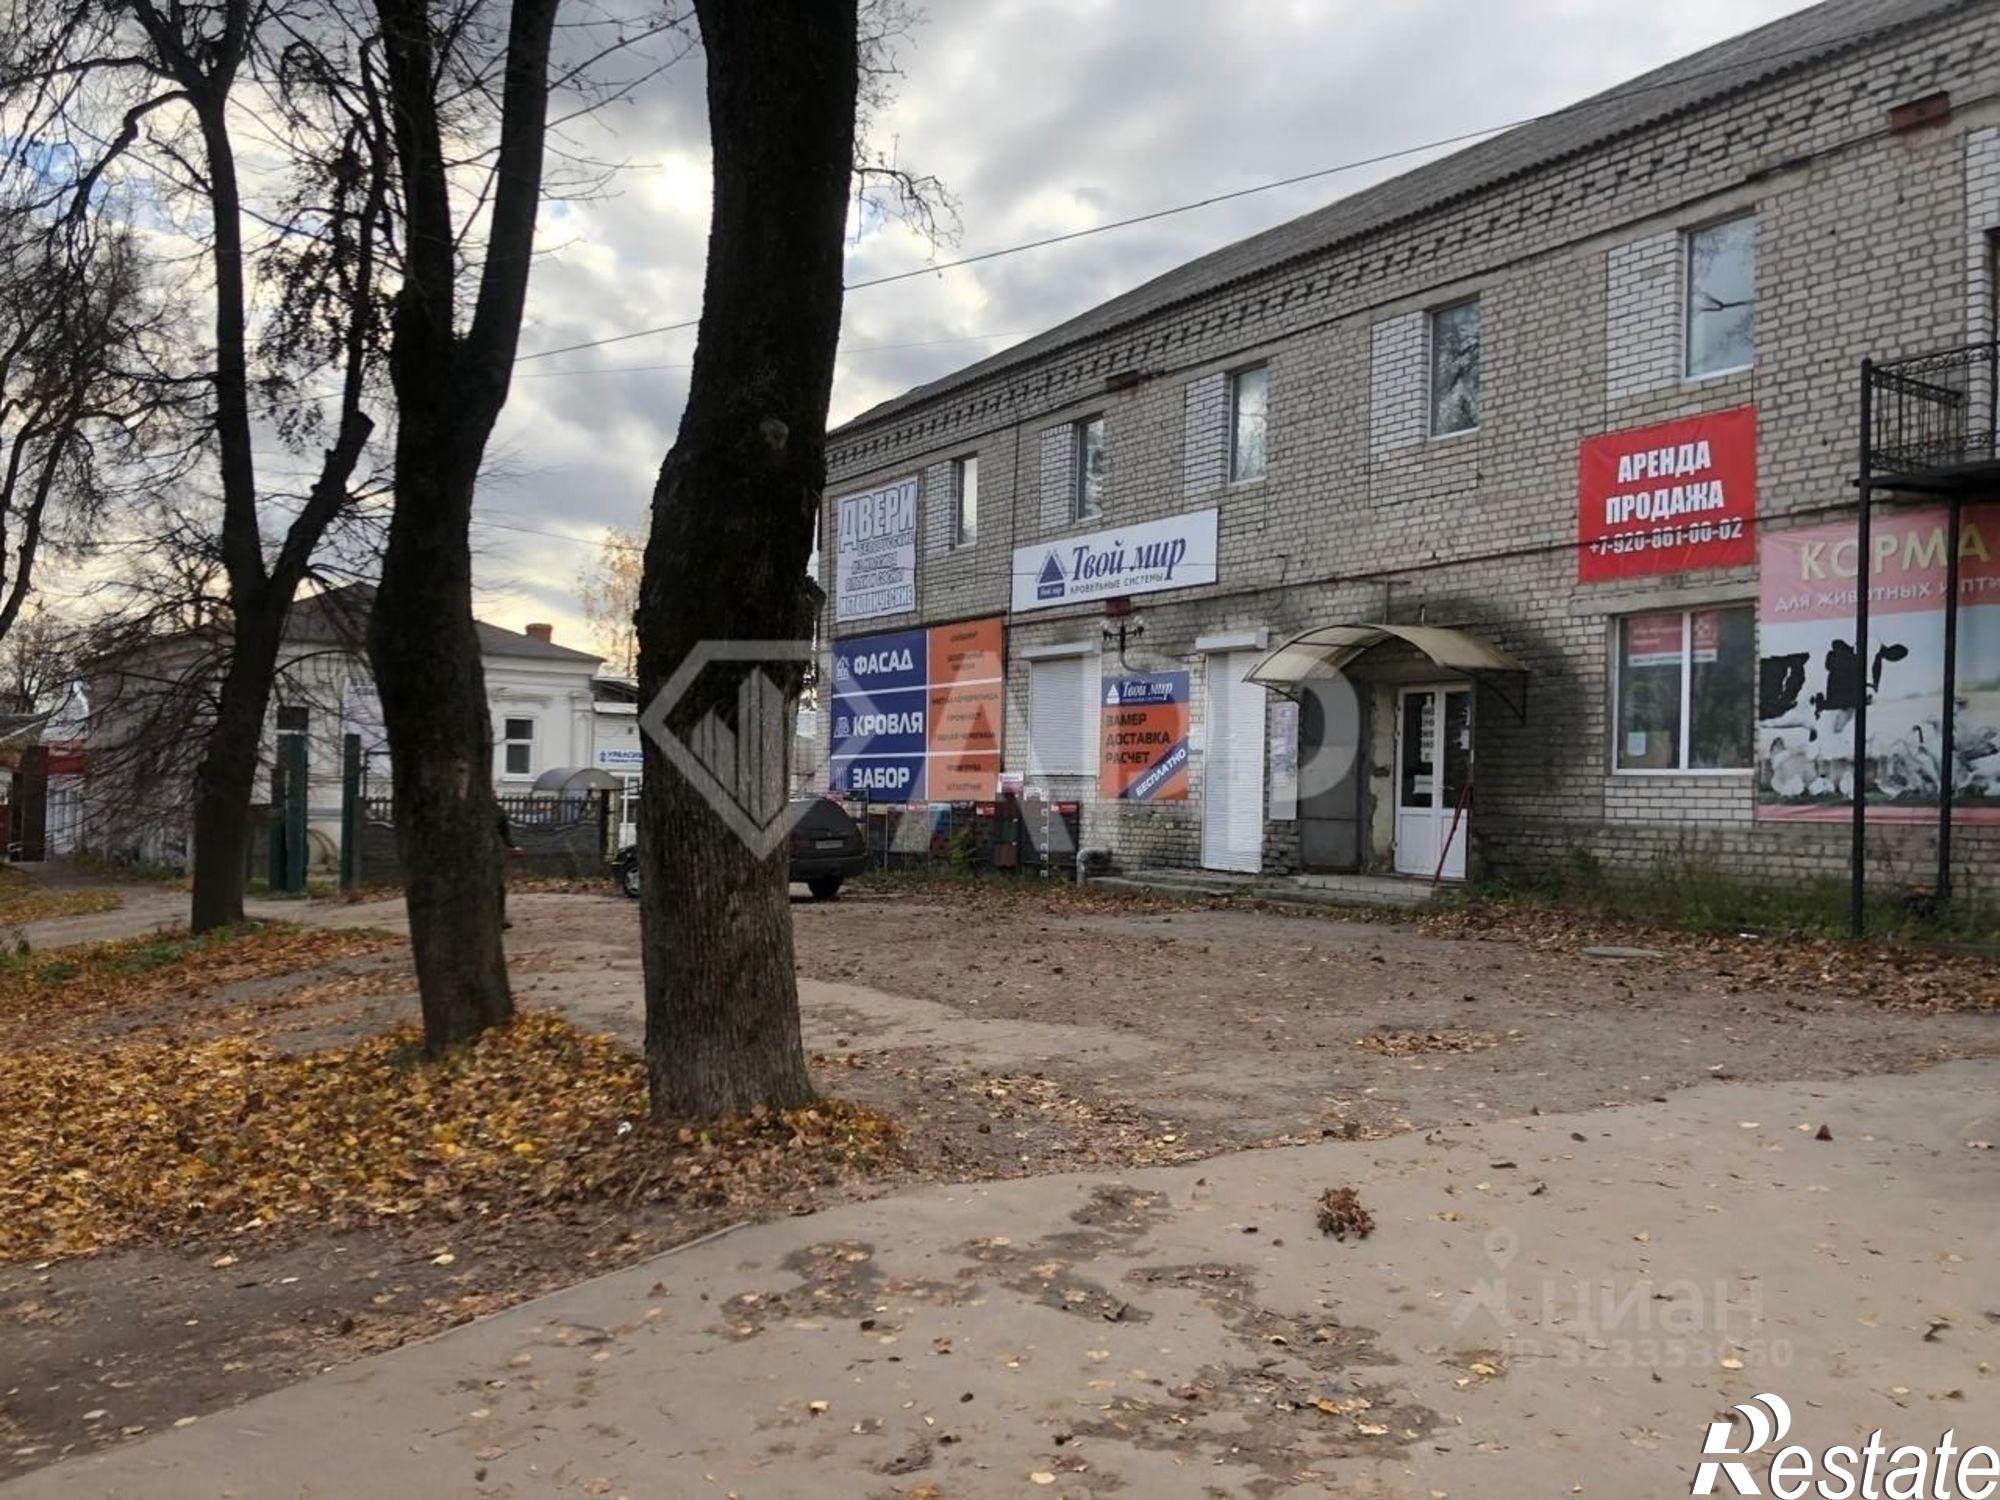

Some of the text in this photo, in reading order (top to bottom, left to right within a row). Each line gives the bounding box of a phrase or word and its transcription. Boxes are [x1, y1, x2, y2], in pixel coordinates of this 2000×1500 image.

[1617, 440, 1712, 484] АРЕНДА
[1605, 480, 1725, 525] ПРОДАЖА
[839, 482, 916, 553] ДВЕРИ
[1072, 537, 1187, 581] Твой мир
[1801, 522, 1990, 581] КОРМА
[1070, 572, 1164, 595] КРОВЕЛЬНЫЕ СИСТЕМЫ
[853, 649, 914, 675] ФАСАД
[852, 711, 924, 737] КРОВЛЯ
[1105, 713, 1147, 726] ЗАМЕР
[1105, 731, 1170, 746] ДОСТАВКА
[1105, 751, 1151, 765] РАСЧЕТ
[852, 767, 911, 789] ЗАБОР
[1135, 748, 1187, 797] БЕСПЛАТНО
